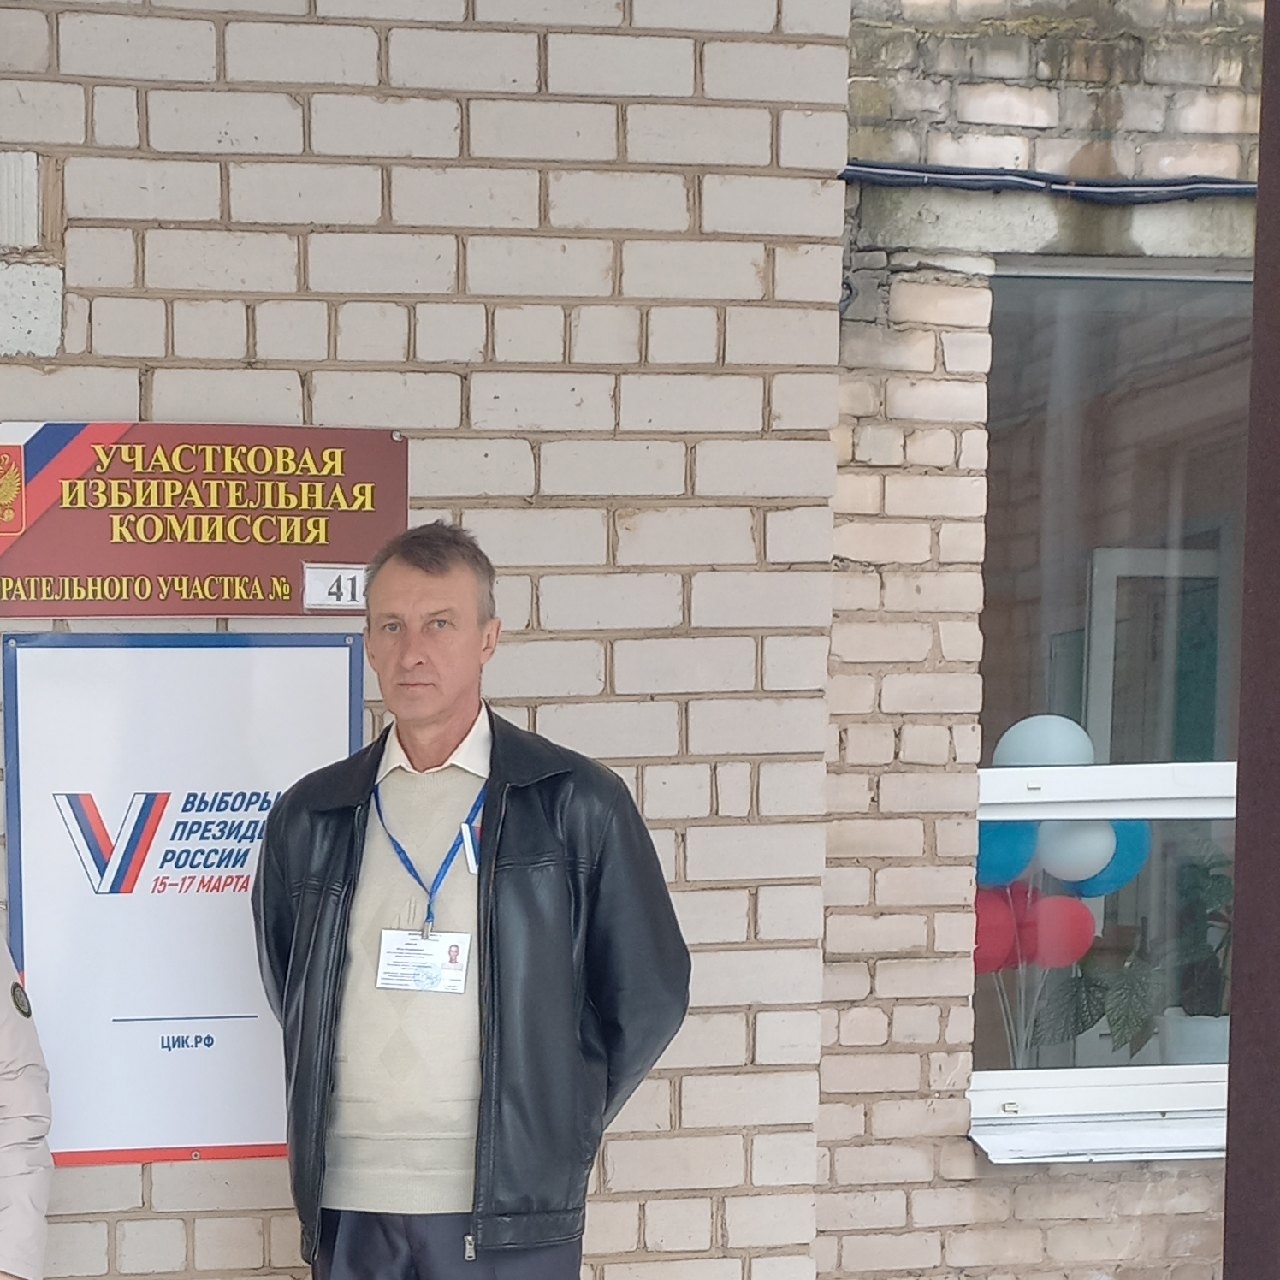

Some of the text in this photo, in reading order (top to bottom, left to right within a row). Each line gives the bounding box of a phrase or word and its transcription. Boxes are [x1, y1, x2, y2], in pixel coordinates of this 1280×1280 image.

[91, 443, 346, 477] УЧАСТКОВАЯ
[59, 478, 376, 512] ИЗБИРАТЕЛЬНАЯ
[109, 513, 330, 545] КОМИССИЯ
[157, 574, 265, 601] УЧАСТКА
[269, 576, 291, 600] №
[327, 574, 366, 603] 41
[158, 848, 251, 869] РОССИИ
[196, 874, 251, 893] МАРТА
[161, 1034, 214, 1052] ЦИК.РФ
